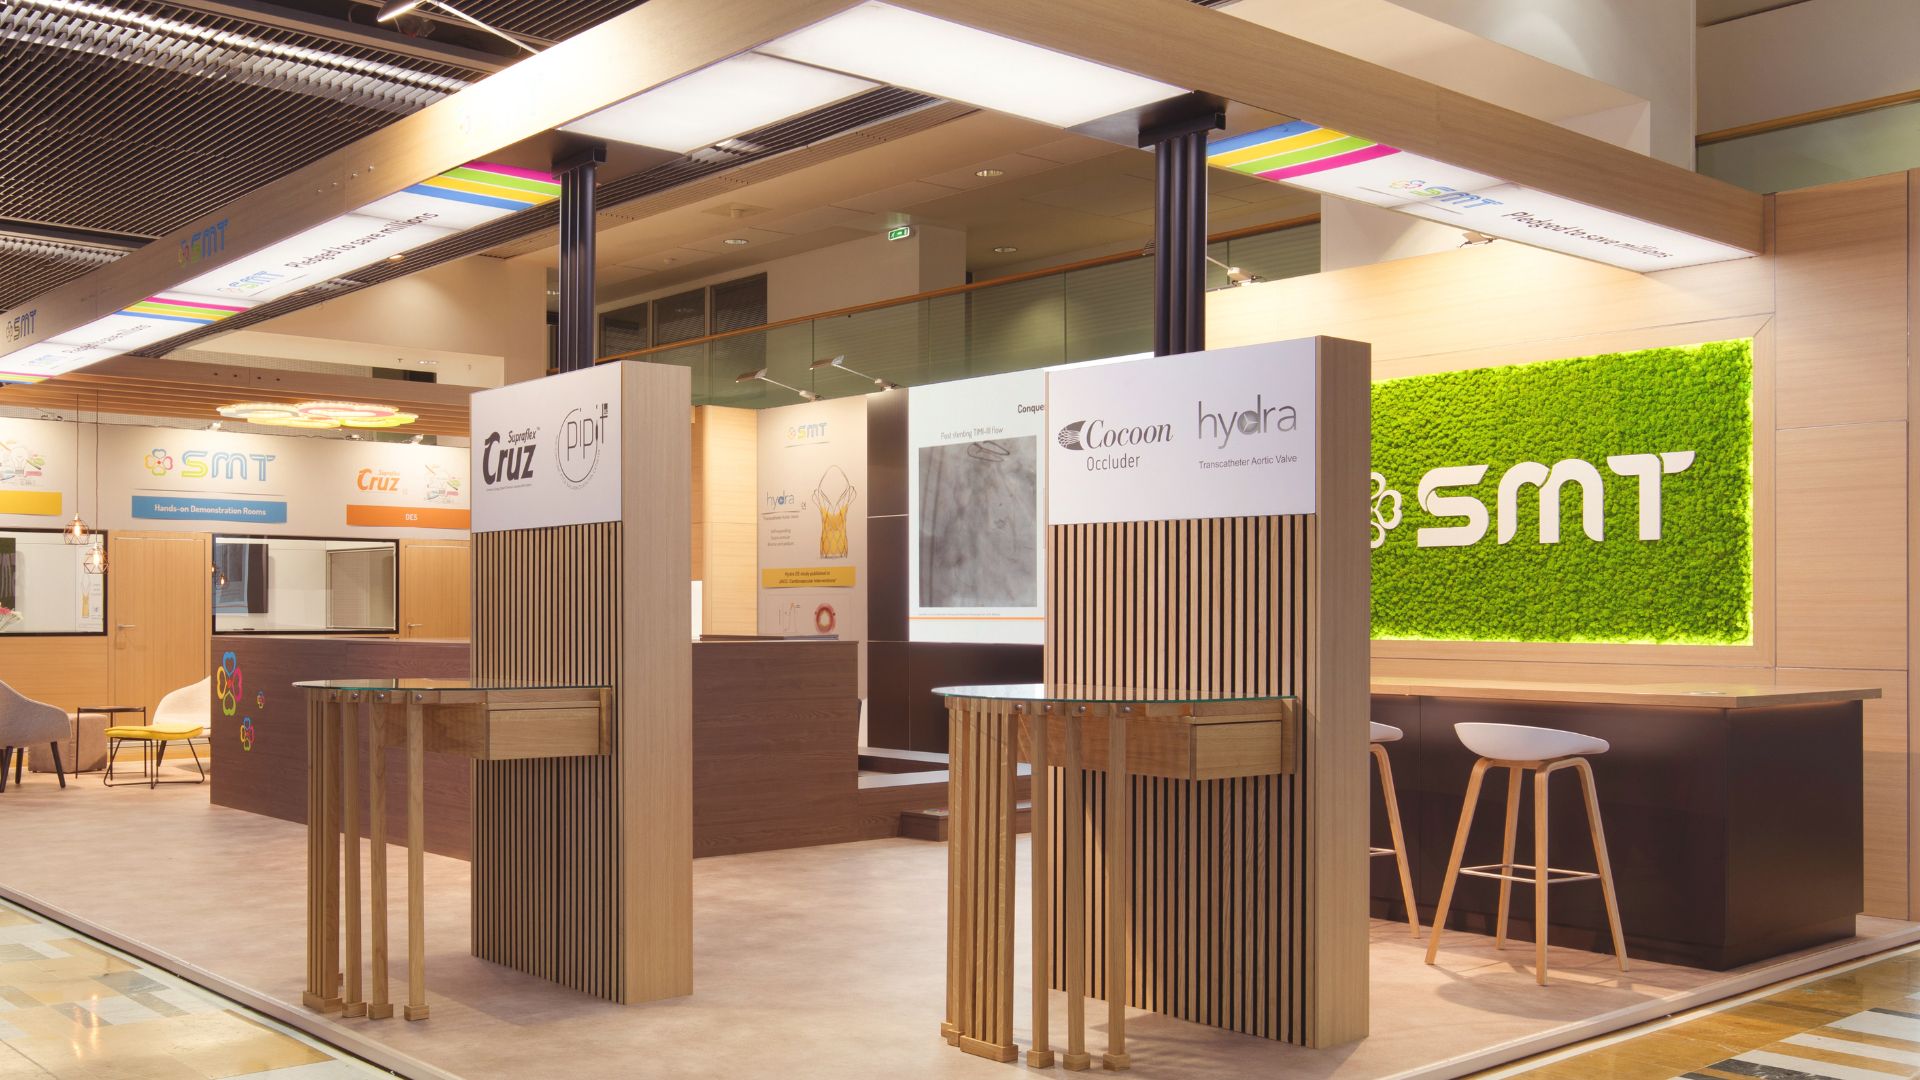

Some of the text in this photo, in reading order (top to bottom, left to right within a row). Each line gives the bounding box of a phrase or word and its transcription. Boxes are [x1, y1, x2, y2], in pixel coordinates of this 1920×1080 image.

[1410, 185, 1504, 209] SMT
[191, 218, 228, 263] SMT
[284, 246, 341, 269] Pledged
[353, 233, 386, 246] save
[380, 212, 439, 235] millions
[1501, 211, 1574, 234] Pledged
[1582, 234, 1619, 245] save
[13, 309, 37, 341] SMT
[567, 402, 608, 461] pipit
[798, 423, 827, 439] SMT
[992, 426, 1004, 434] flow
[1086, 419, 1173, 449] Cocoon
[1198, 394, 1297, 449] hydra
[181, 450, 276, 481] SMT
[483, 432, 536, 485] Cruz
[1086, 454, 1140, 471] Occluder
[1199, 454, 1297, 469] Transcatheter Aortic Valve
[357, 468, 400, 491] Cruz
[154, 504, 267, 516] Hands-on Demonstration Rooms
[767, 489, 795, 510] hydra
[1417, 450, 1696, 548] SMT
